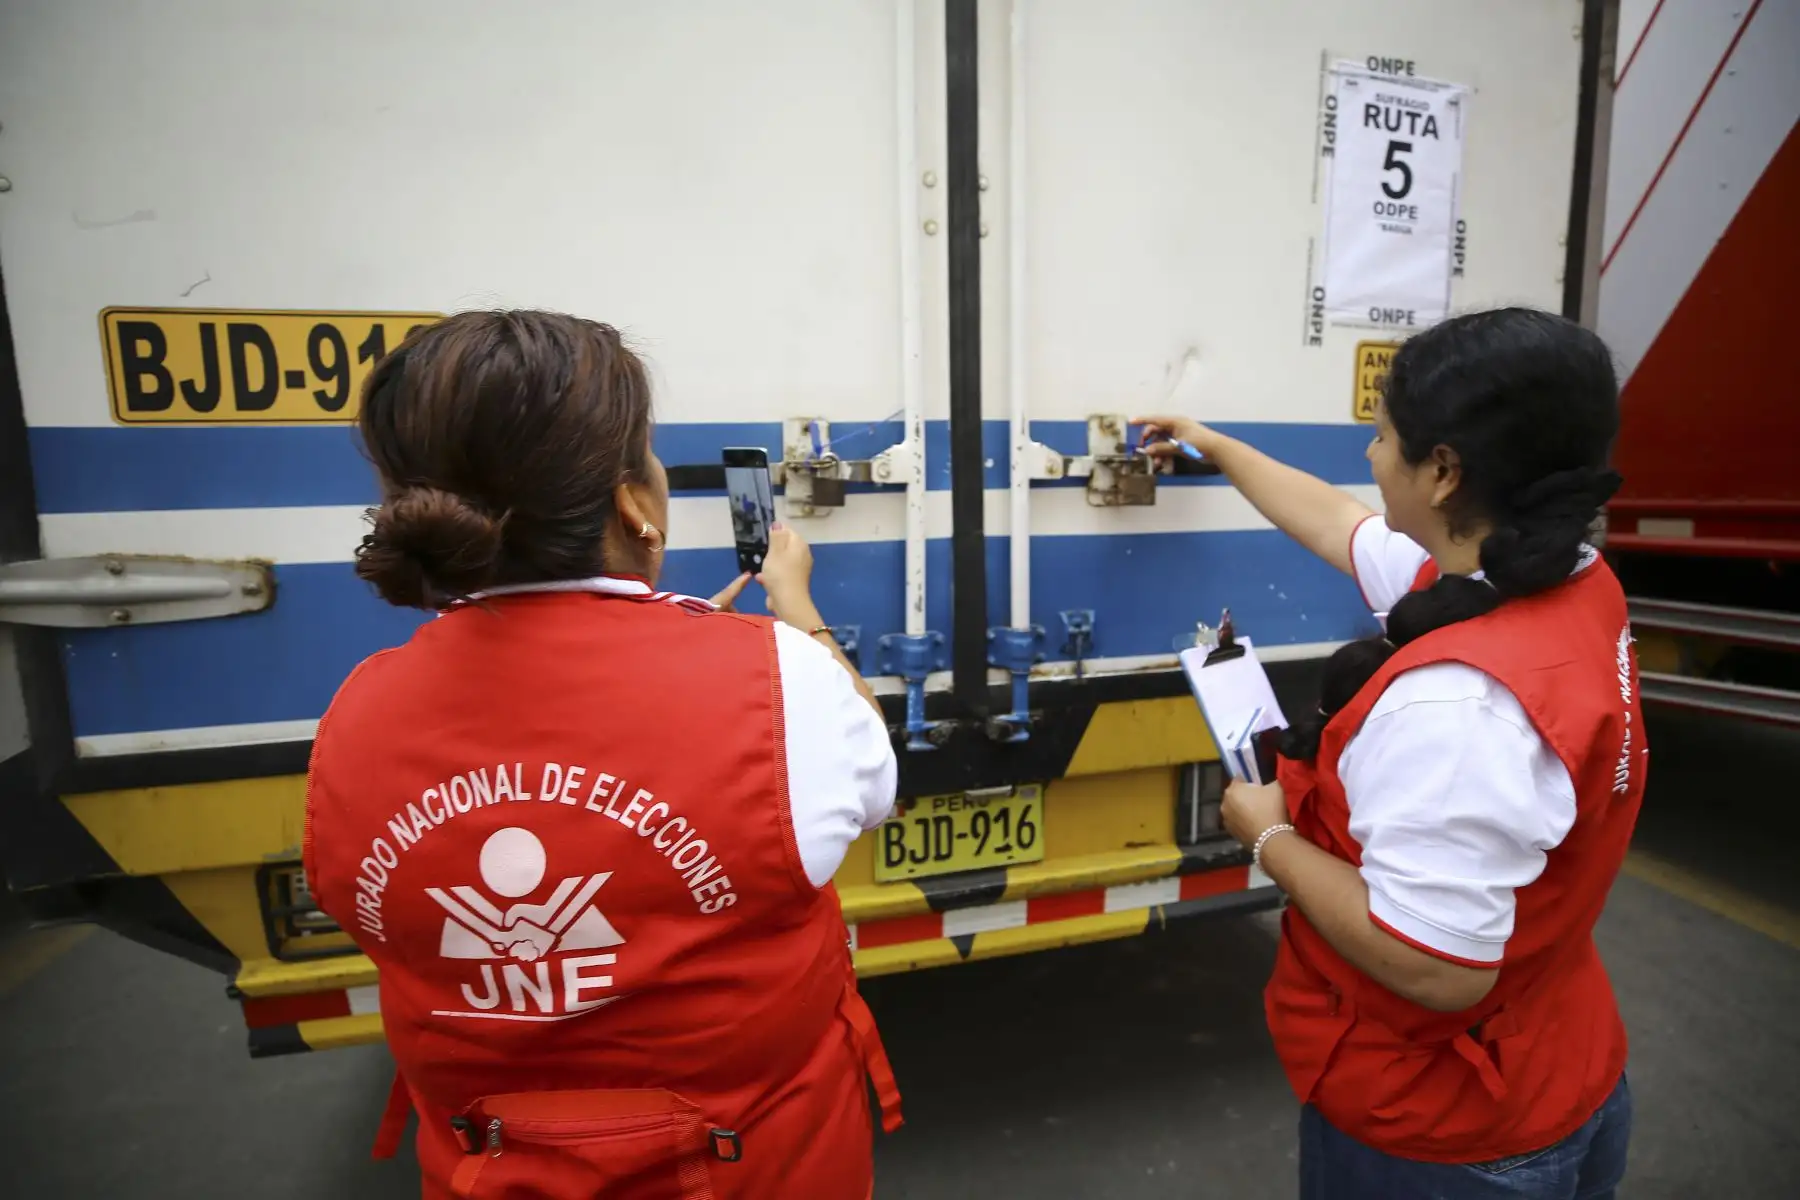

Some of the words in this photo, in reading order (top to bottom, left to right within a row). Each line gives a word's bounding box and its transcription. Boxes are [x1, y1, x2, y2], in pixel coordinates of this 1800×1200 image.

[1366, 55, 1416, 77] ONPE
[1321, 94, 1339, 158] ONPE
[1362, 102, 1440, 141] RUTA
[1374, 92, 1431, 112] SUFRAGIO
[1380, 139, 1414, 201] 5
[1372, 201, 1418, 221] ODPE
[1452, 219, 1468, 279] ONPE
[1309, 285, 1326, 347] ONPE
[1368, 307, 1416, 326] ONPE
[116, 320, 424, 413] BJD-91
[355, 836, 399, 943] JURADO
[386, 762, 533, 852] NACIONAL
[538, 762, 587, 806] DE
[584, 772, 739, 915] ELECCIONES
[884, 804, 1036, 869] BJD-916
[460, 953, 618, 1014] JNE
